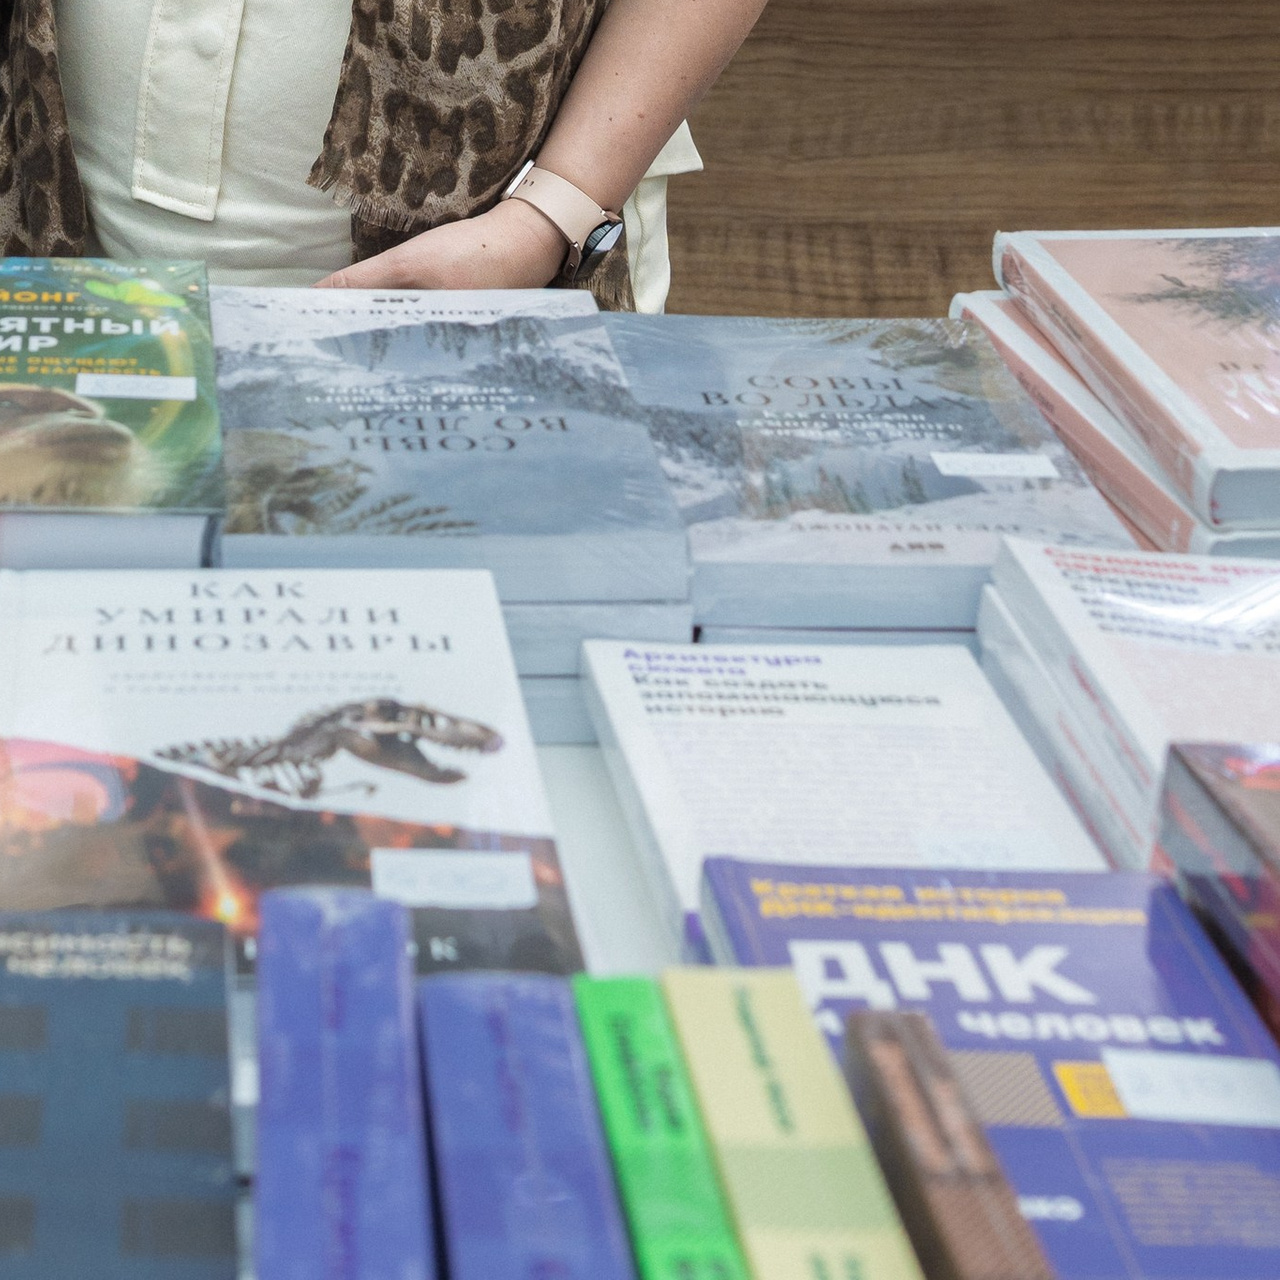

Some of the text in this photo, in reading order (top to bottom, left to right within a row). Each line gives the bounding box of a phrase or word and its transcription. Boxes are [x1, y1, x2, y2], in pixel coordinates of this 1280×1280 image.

[747, 375, 905, 391] СОВЫ
[700, 391, 972, 410] ВО ЛЬДАХ
[190, 581, 307, 599] КАК
[95, 606, 402, 626] УМИРАЛИ
[42, 632, 454, 654] ДИНОЗАВРЫ
[787, 938, 1099, 1011] ДНК
[957, 1009, 1226, 1046] человек
